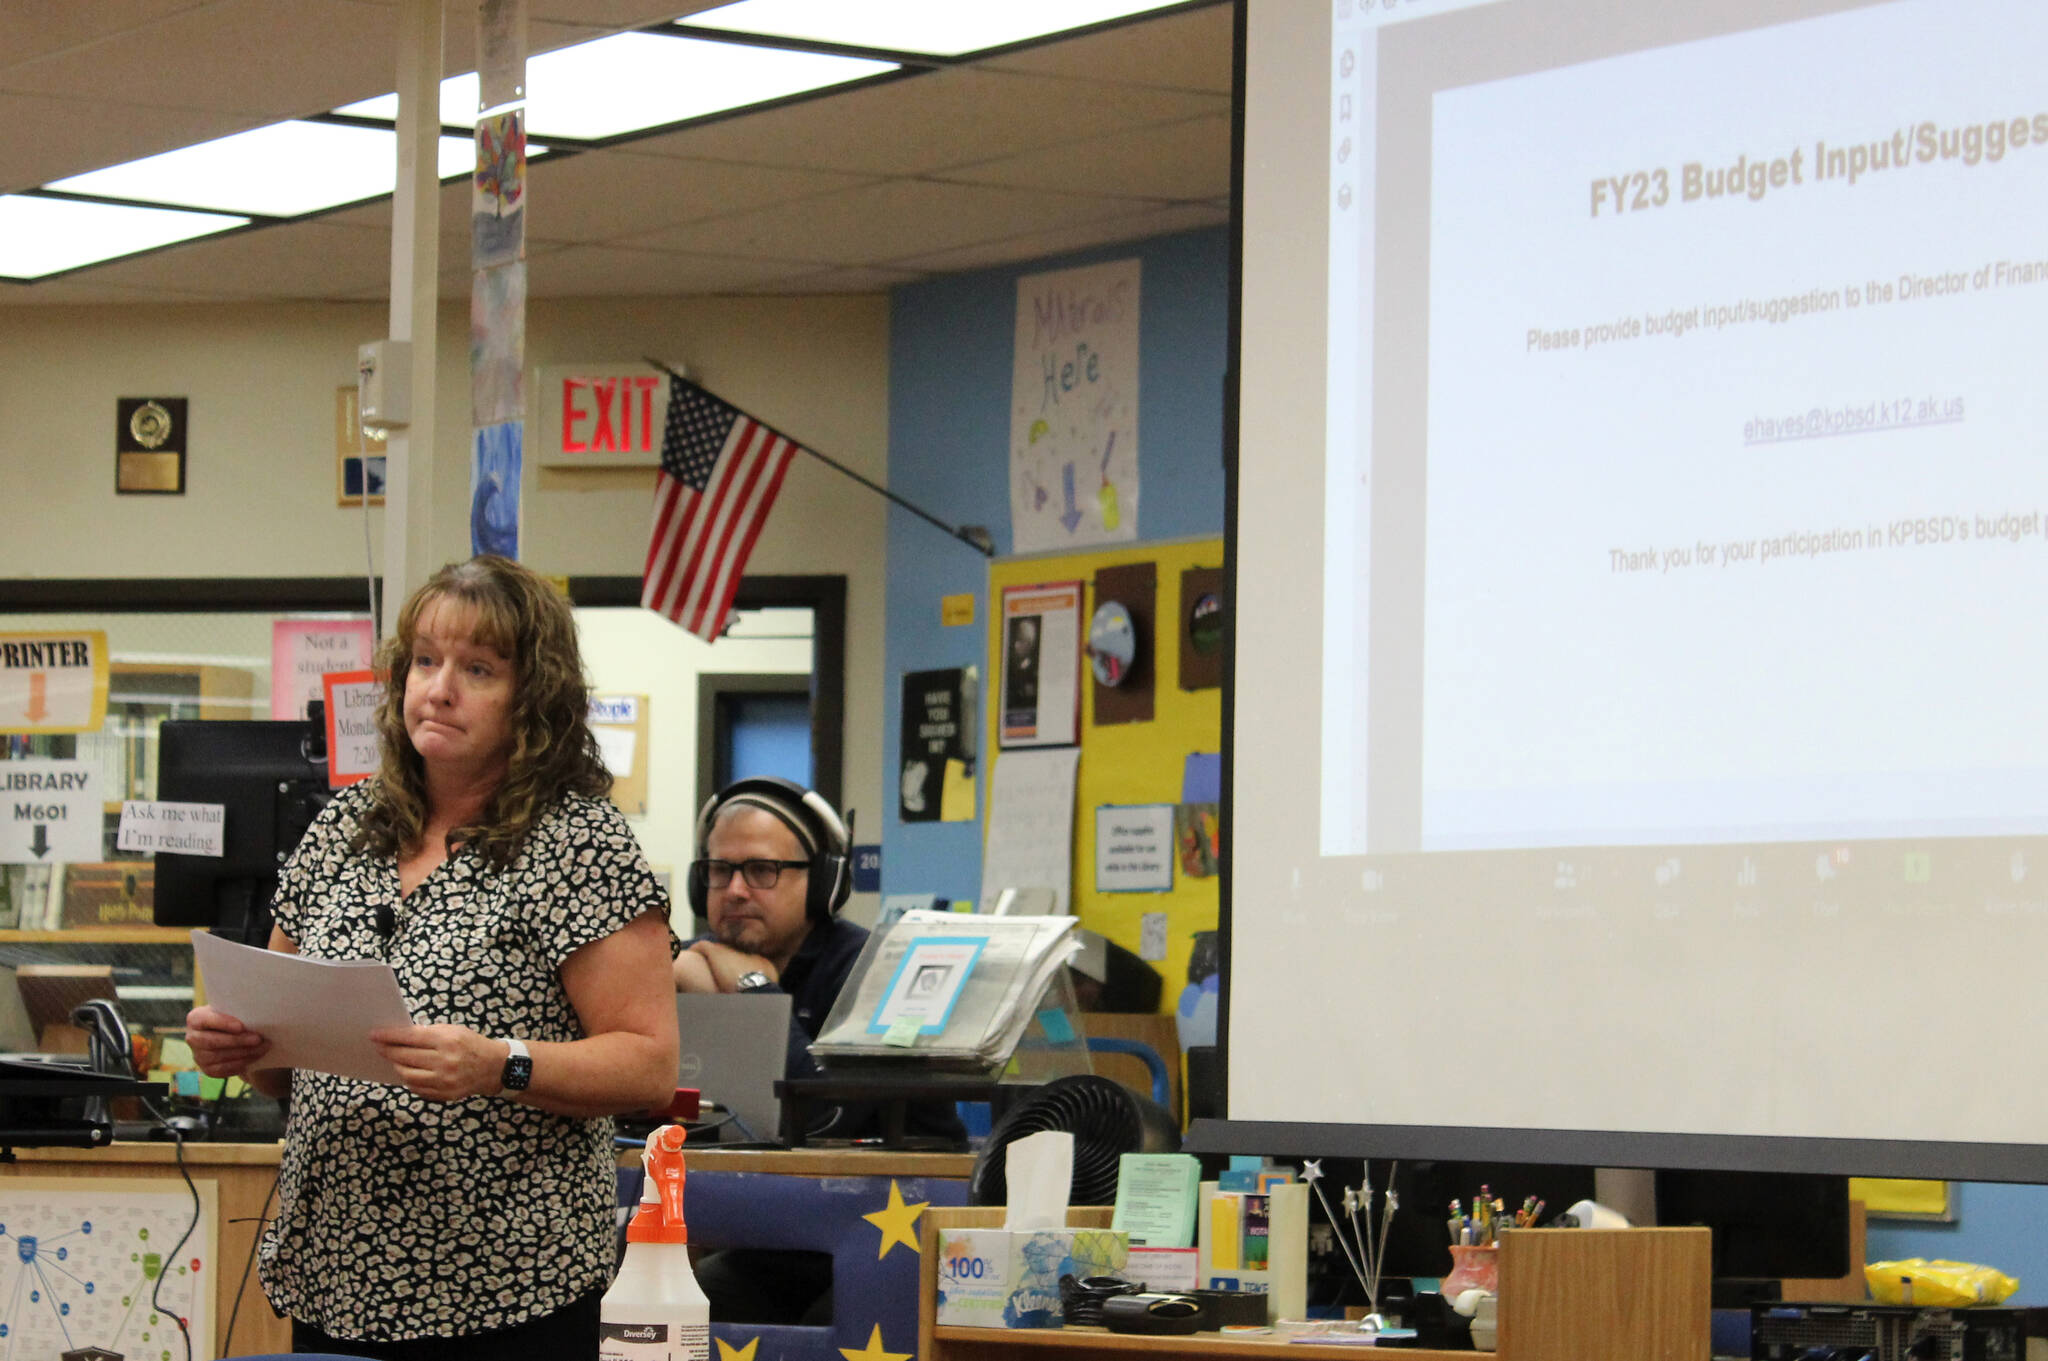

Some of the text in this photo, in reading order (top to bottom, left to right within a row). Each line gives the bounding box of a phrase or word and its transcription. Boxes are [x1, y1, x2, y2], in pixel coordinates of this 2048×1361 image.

[1590, 112, 2048, 218] FY23 Budget Input/Sugges
[1526, 326, 1581, 353] Please
[1583, 314, 1641, 350] provide
[1645, 307, 1700, 338] budget
[1703, 286, 1840, 330] input/suggestion
[1844, 283, 1862, 309] to
[1866, 279, 1894, 305] the
[1898, 270, 1970, 301] Director
[1971, 261, 1991, 290] of
[1039, 341, 1101, 412] Here
[562, 376, 660, 453] EXIT
[1607, 546, 1658, 575] Thank
[1662, 549, 1693, 575] you
[1696, 539, 1717, 566] for
[1721, 539, 1756, 568] your
[1760, 525, 1863, 566] participation
[1867, 521, 1883, 549] in
[1887, 514, 1970, 549] KPBSD's
[1974, 507, 2039, 544] budget
[305, 633, 349, 650] Not a
[0, 640, 89, 669] RINTER
[297, 656, 356, 674] student
[343, 688, 378, 709] Librar
[925, 690, 951, 706] HAVE
[927, 706, 949, 722] YOU
[14, 803, 68, 821] M601
[125, 803, 221, 824] Ask me what
[124, 828, 153, 847] I'm
[860, 853, 881, 869] 20
[623, 1328, 657, 1340] Diversey
